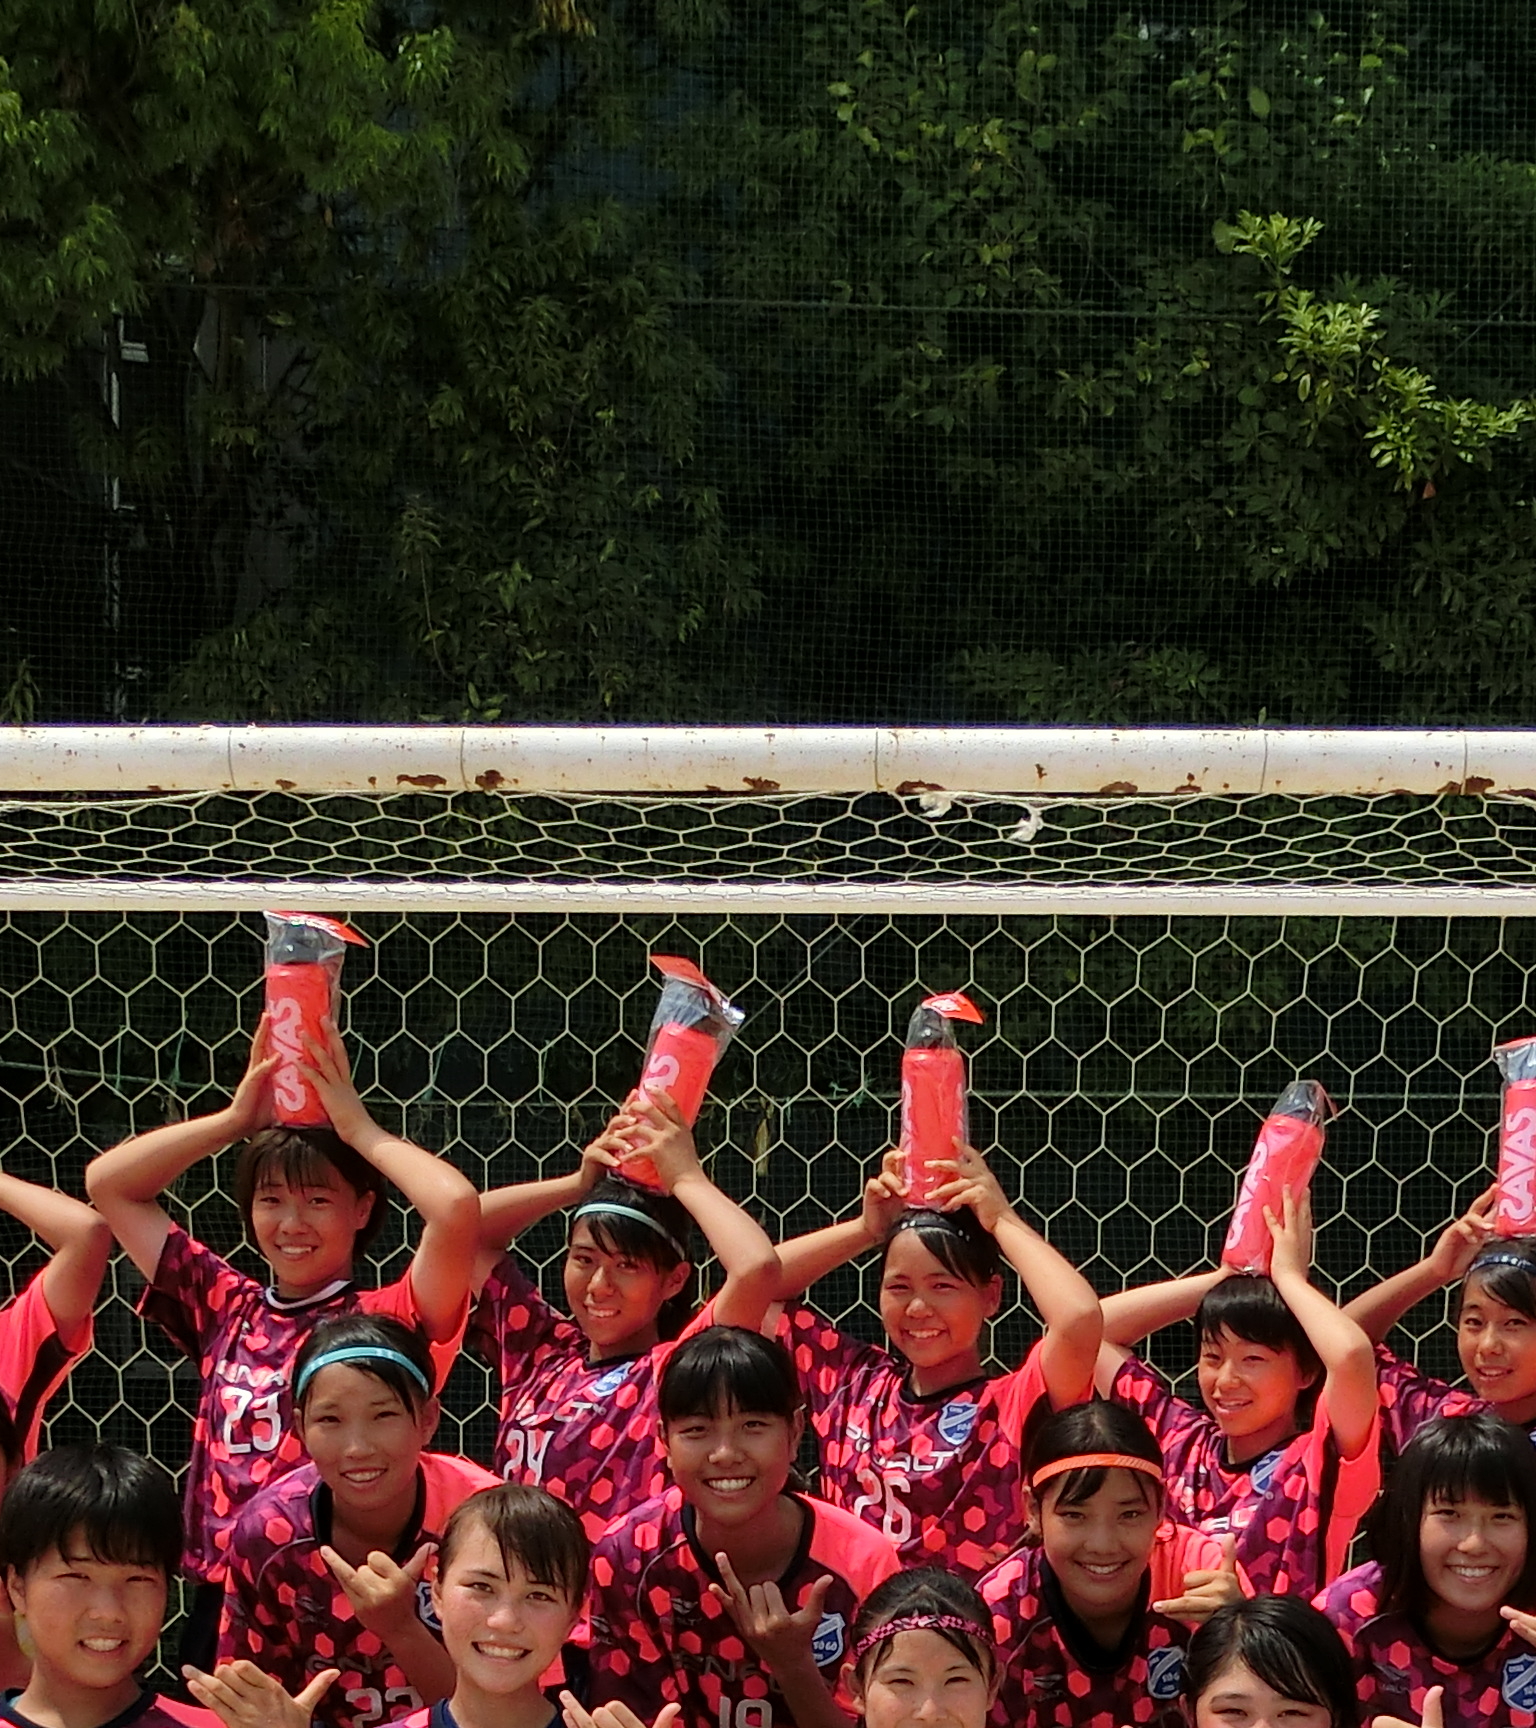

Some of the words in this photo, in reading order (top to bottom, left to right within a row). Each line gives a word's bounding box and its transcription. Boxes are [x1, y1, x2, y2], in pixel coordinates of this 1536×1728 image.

[269, 997, 306, 1112] SAVAS
[221, 1386, 281, 1454] 23
[503, 1430, 554, 1487] 24
[854, 1468, 911, 1543] 26
